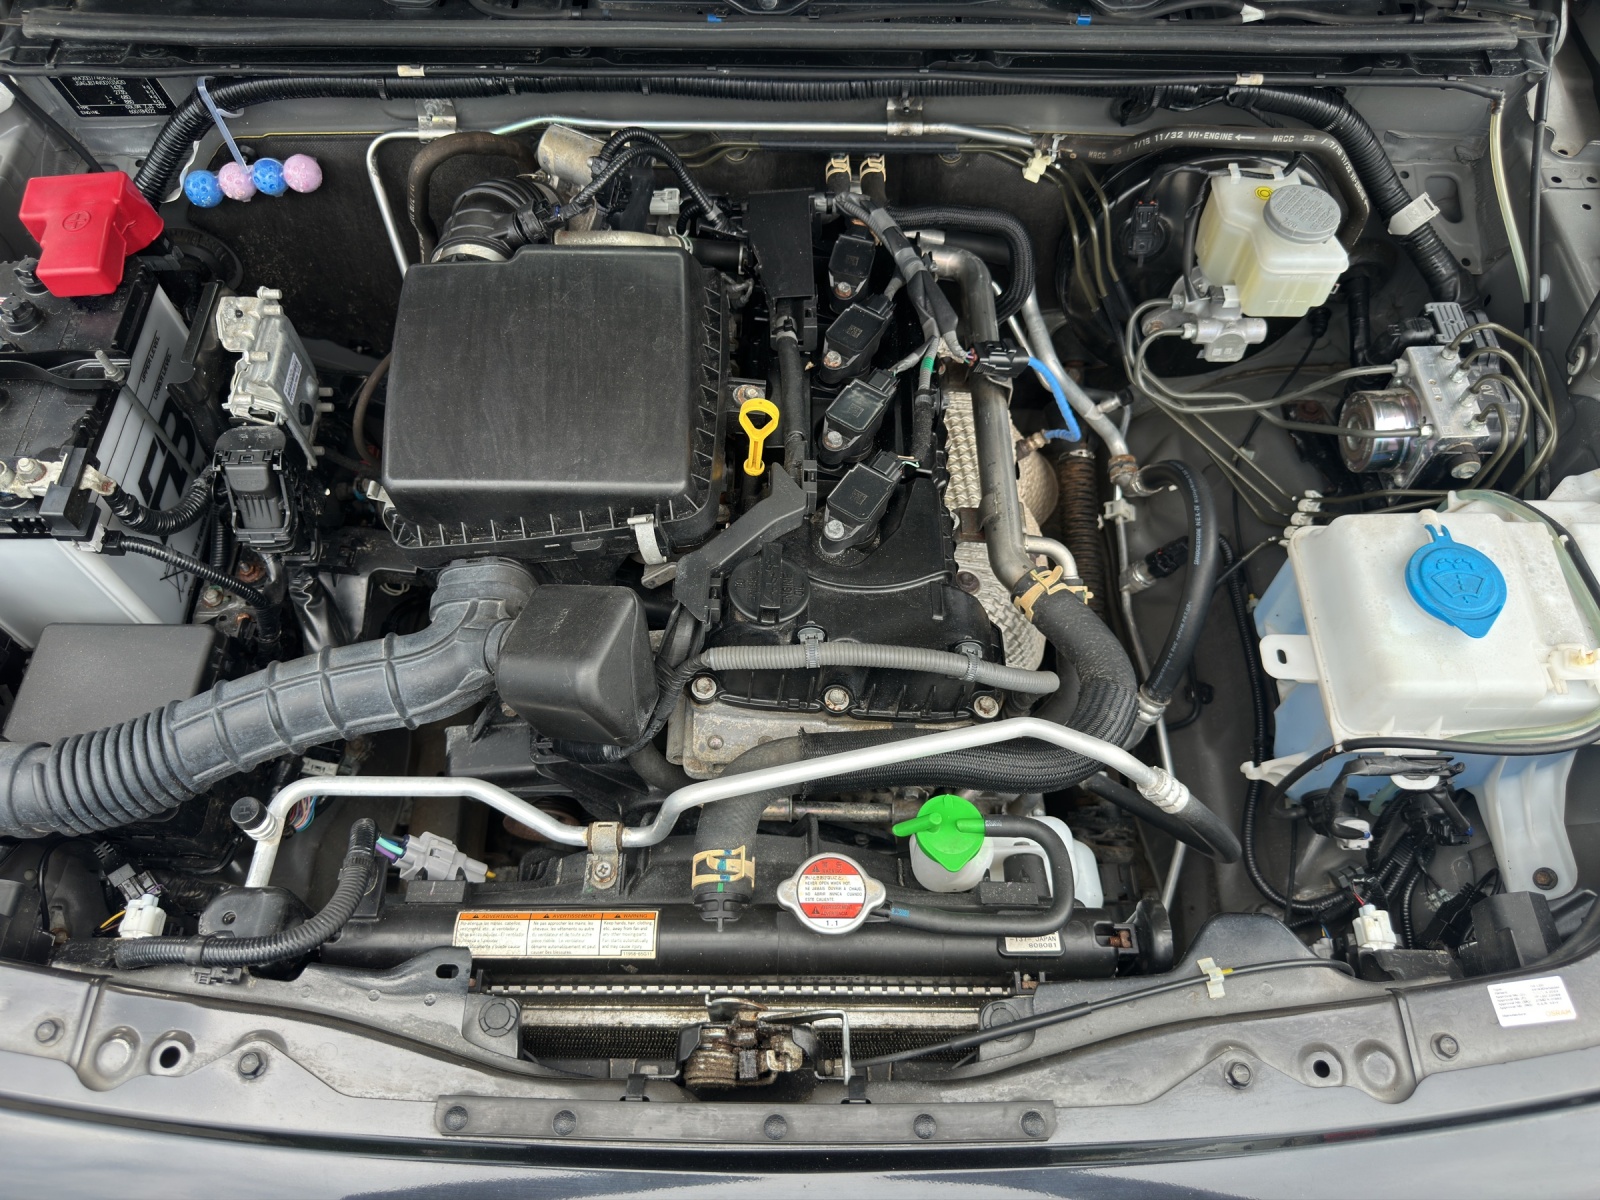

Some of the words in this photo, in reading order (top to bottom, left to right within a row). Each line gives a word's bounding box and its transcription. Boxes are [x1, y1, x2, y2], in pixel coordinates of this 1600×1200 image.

[1154, 131, 1183, 141] 11/32
[1272, 135, 1294, 143] MRCC
[1341, 155, 1351, 174] 11/32
[140, 358, 152, 383] UPPER
[149, 335, 160, 358] LEVEL
[153, 376, 165, 400] LOWER
[162, 353, 172, 376] LEVEL
[782, 572, 794, 604] ENGINE
[794, 582, 804, 596] OIL
[1546, 1009, 1572, 1017] OSRAM
